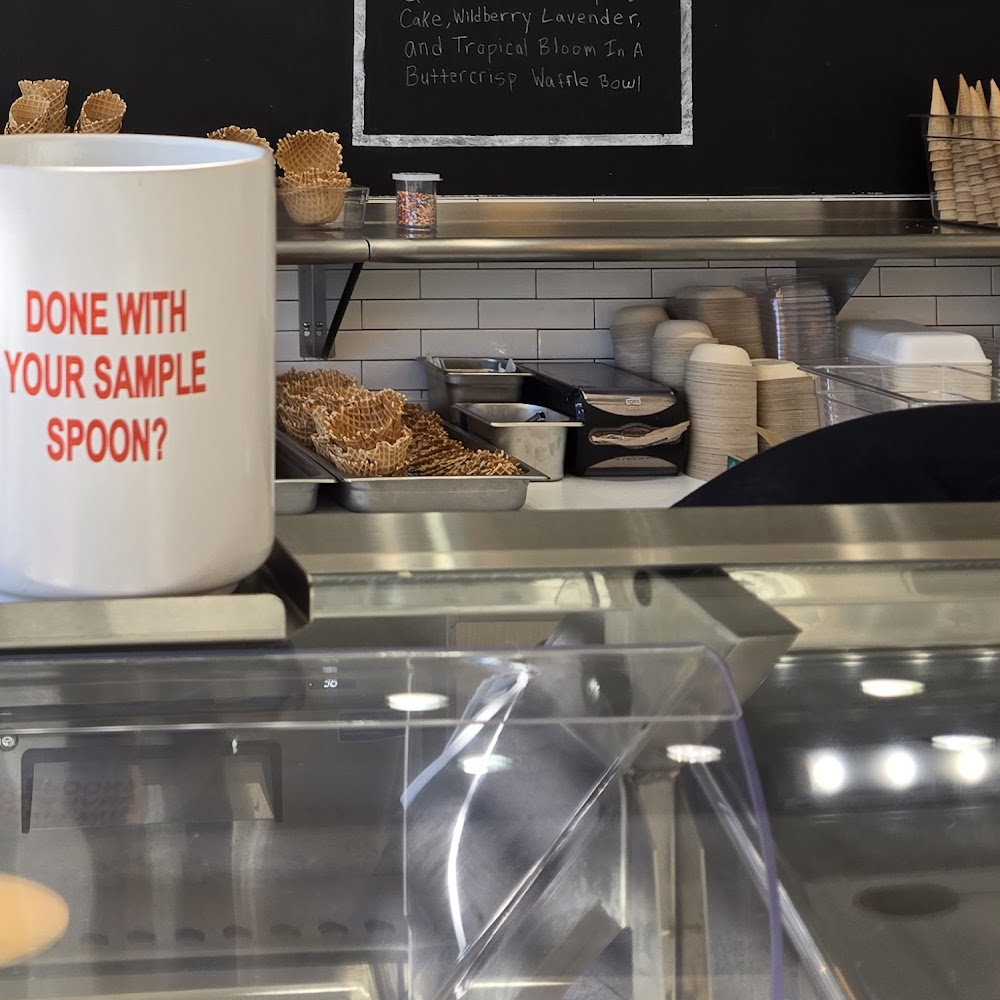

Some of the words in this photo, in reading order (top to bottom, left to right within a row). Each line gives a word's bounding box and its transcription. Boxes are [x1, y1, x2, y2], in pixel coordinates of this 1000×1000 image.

[26, 289, 108, 335] DONE
[117, 289, 186, 335] WITH
[4, 350, 85, 398] YOUR
[94, 350, 207, 399] SAMPLE
[47, 416, 168, 462] SPOON?
